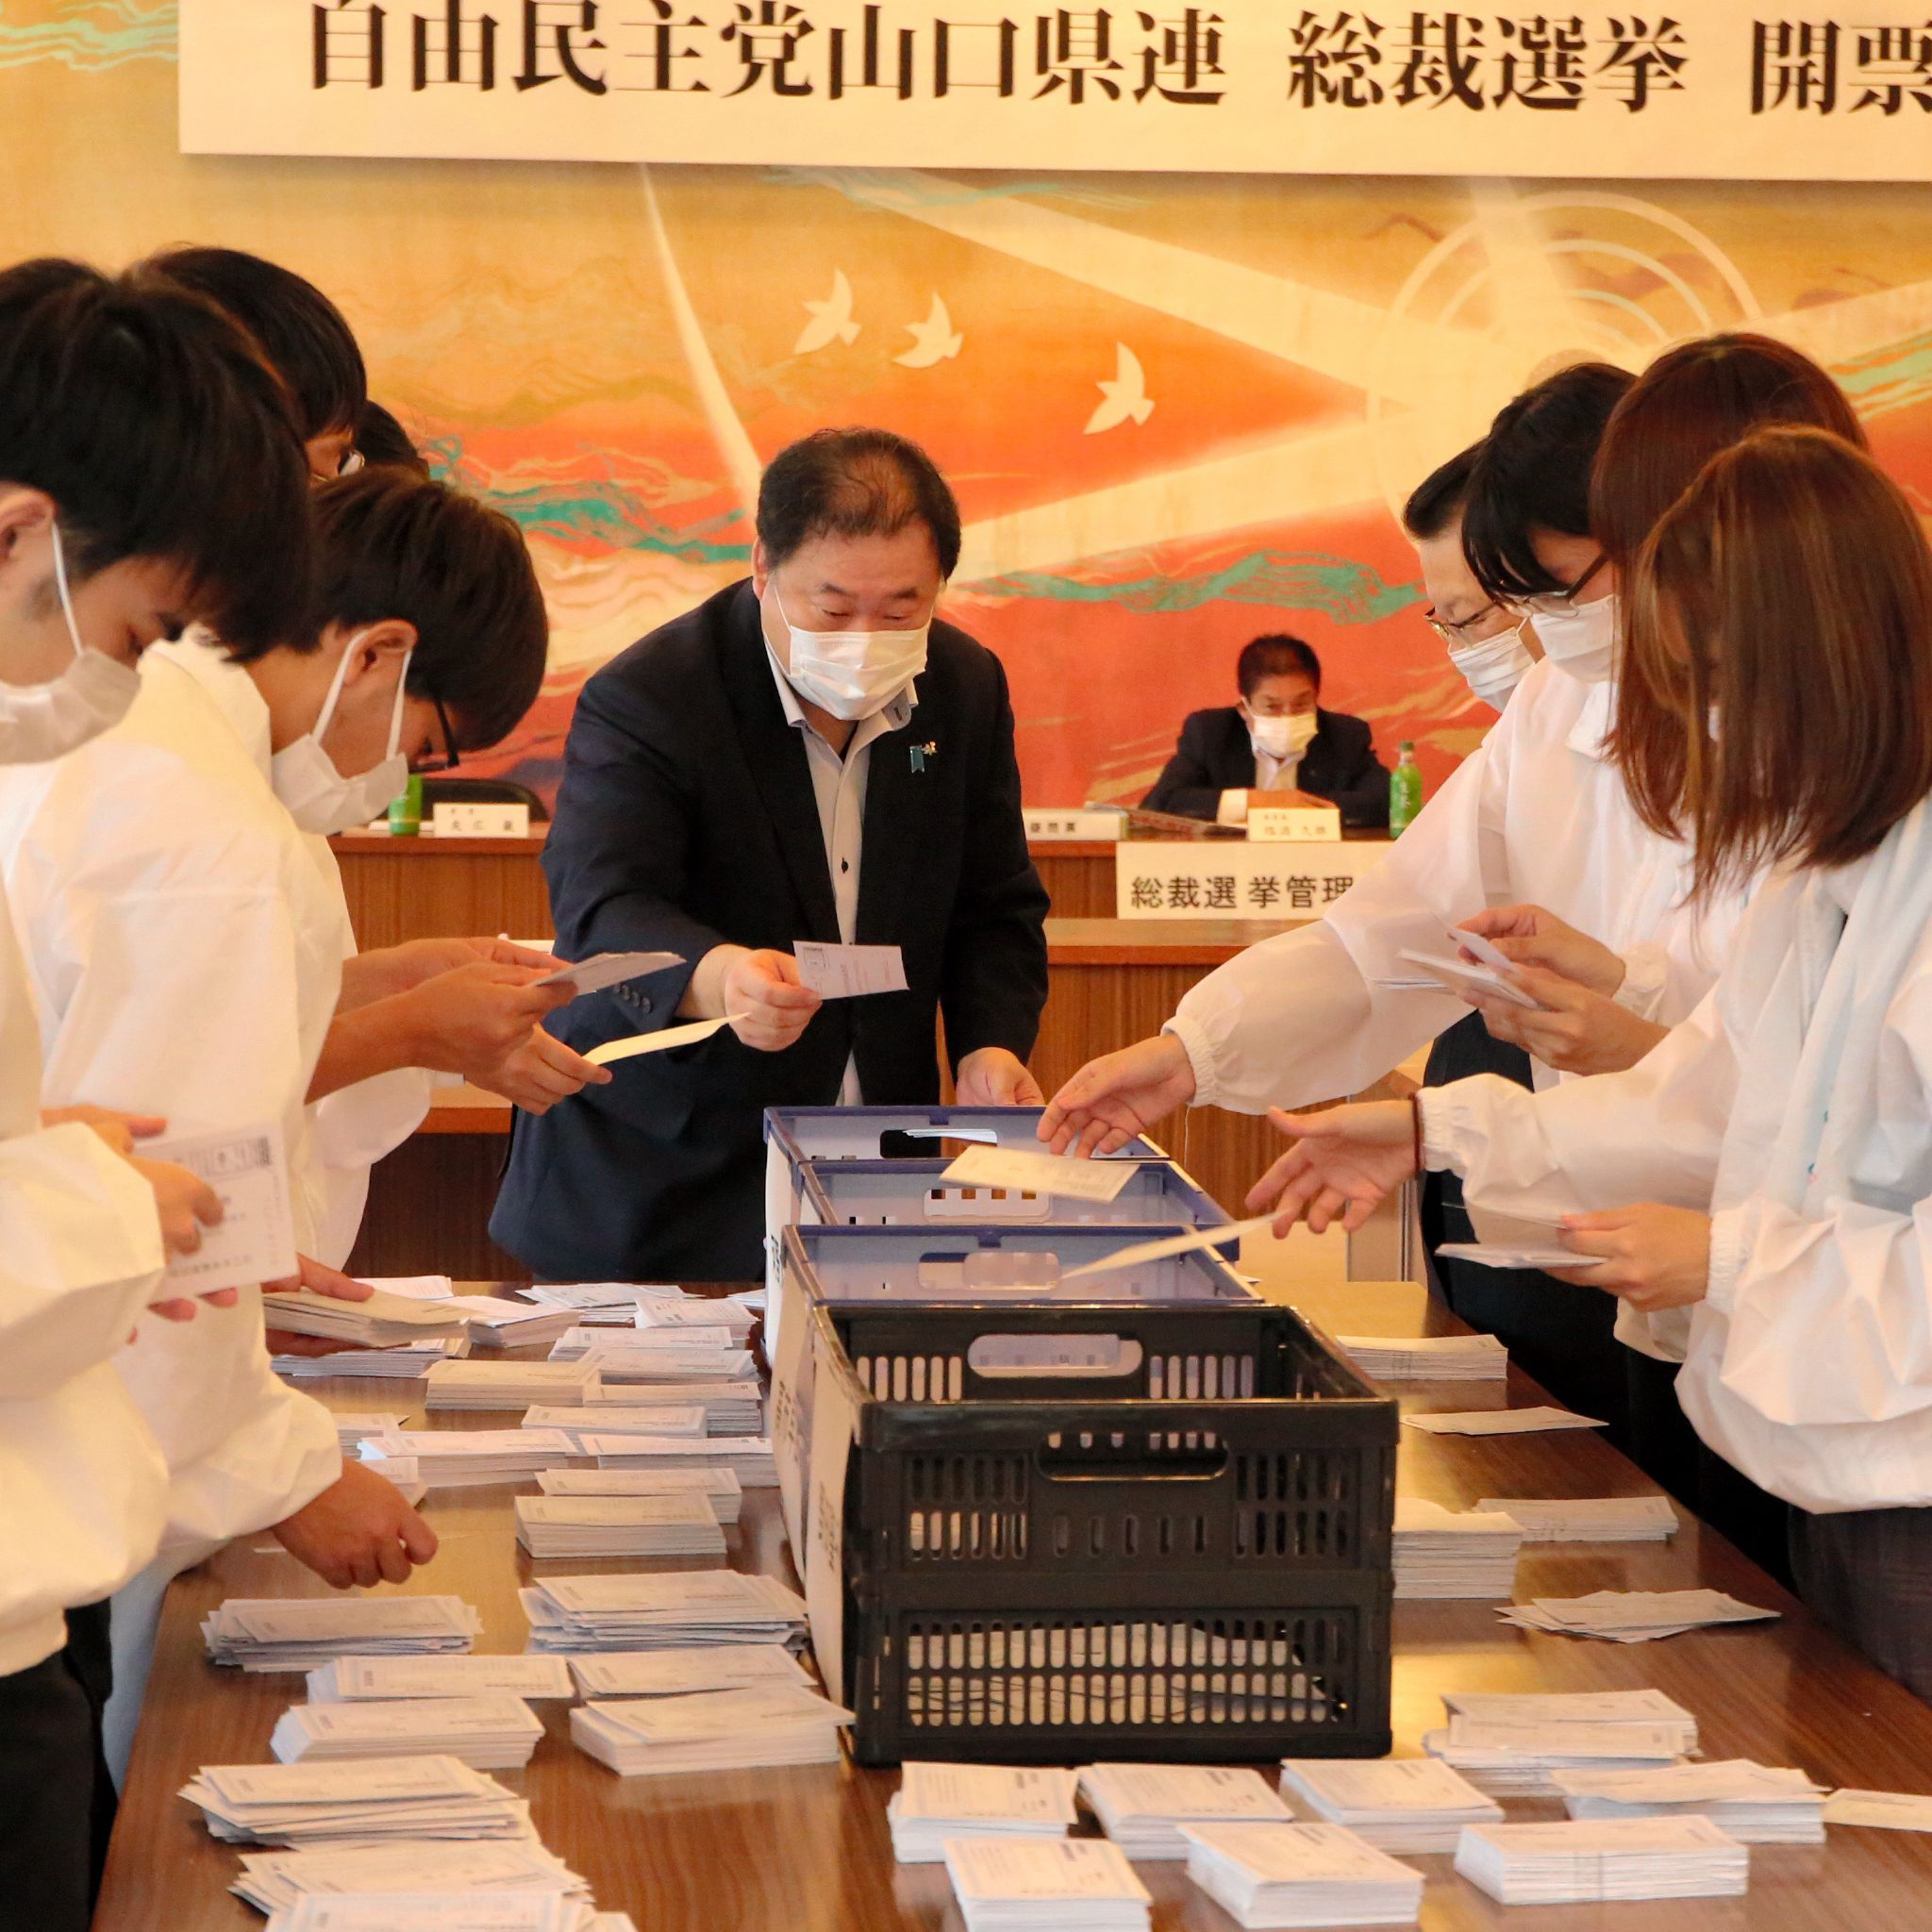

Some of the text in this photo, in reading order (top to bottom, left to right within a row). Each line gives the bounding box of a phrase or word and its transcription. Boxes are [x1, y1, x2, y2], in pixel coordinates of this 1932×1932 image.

[312, 0, 1932, 117] 自由民主党山口県連 総裁選挙 開票
[1131, 875, 1354, 909] 総裁選挙管理
